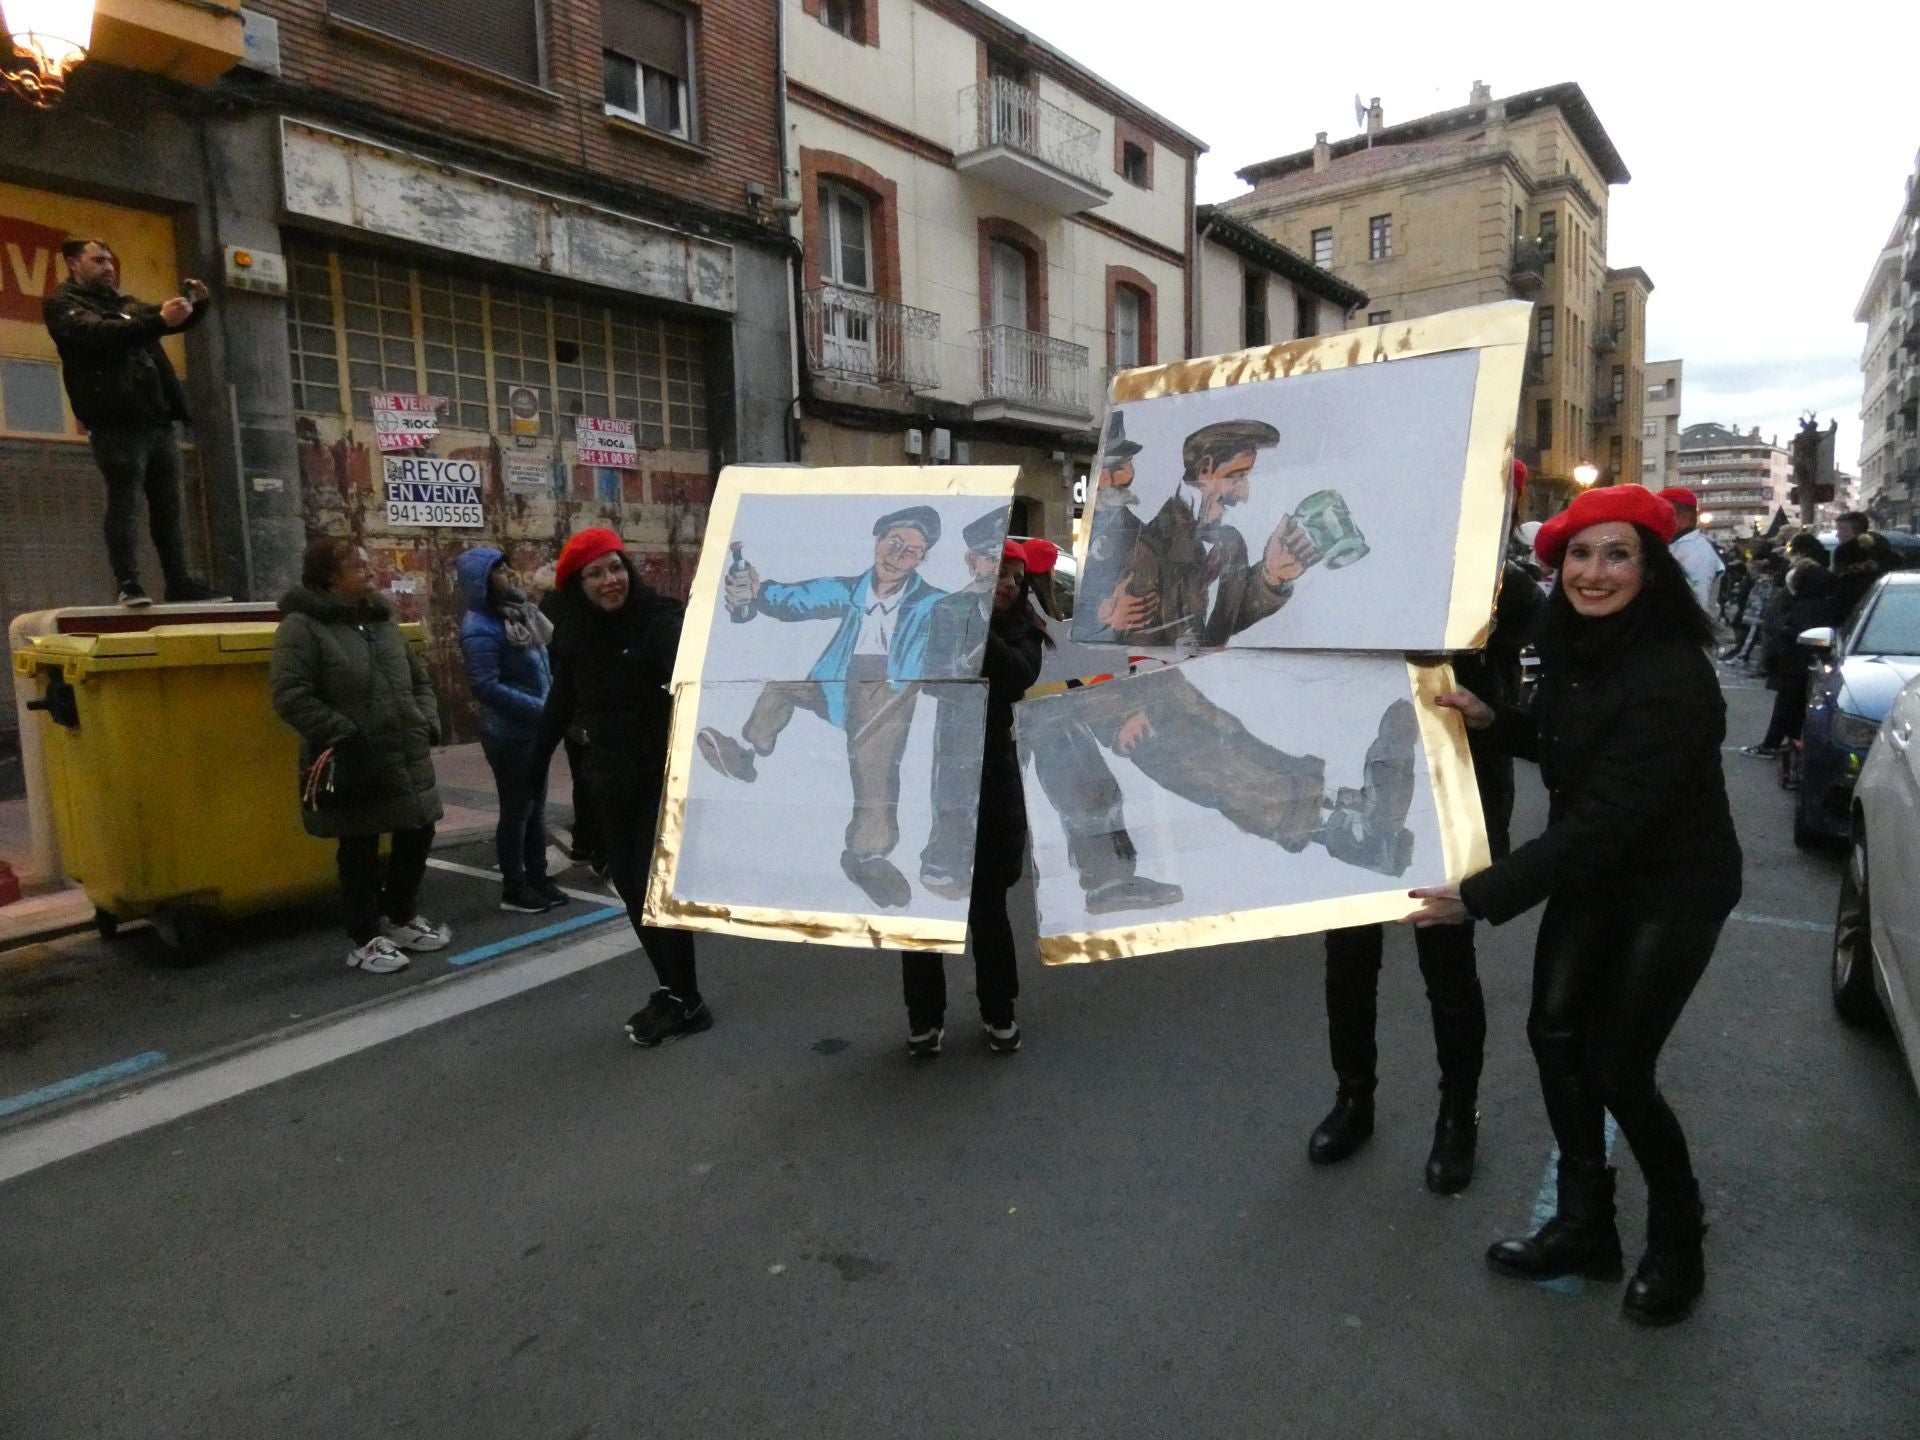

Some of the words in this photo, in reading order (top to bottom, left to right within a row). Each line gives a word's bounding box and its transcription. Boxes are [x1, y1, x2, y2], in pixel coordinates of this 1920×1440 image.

[374, 396, 397, 411] ME
[578, 418, 595, 430] ME
[597, 419, 632, 433] VENDE
[379, 434, 402, 447] 941
[404, 433, 421, 446] 31
[579, 449, 596, 462] 941
[598, 451, 609, 463] 31
[611, 452, 623, 465] 00
[402, 459, 476, 483] REYCO
[388, 484, 414, 502] EN
[417, 484, 480, 504] VENTA
